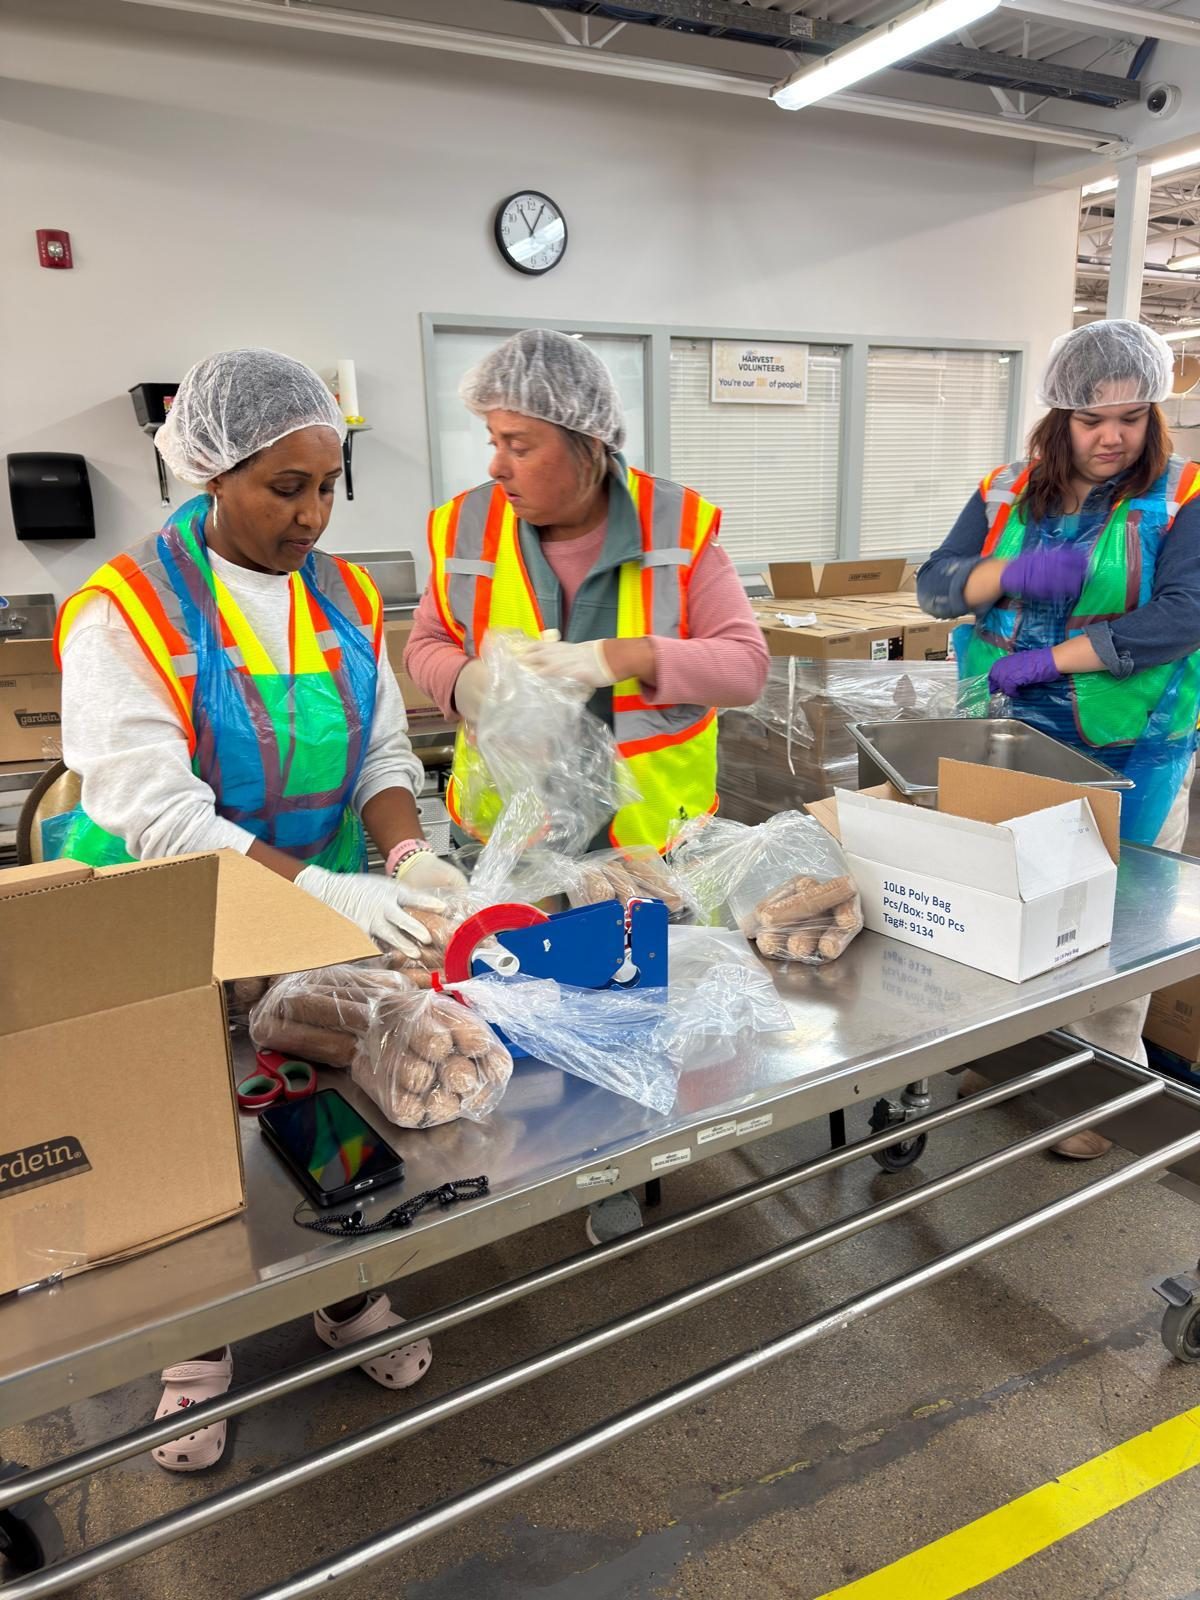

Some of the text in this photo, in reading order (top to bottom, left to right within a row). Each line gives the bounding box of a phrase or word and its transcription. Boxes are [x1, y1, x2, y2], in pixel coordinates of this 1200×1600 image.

[742, 355, 774, 364] HARVEST
[738, 363, 785, 373] VOLUNTEERS
[719, 378, 741, 387] You're
[769, 380, 777, 388] of
[777, 380, 802, 389] people!
[21, 712, 57, 725] gardein
[883, 880, 952, 913] 10LB Poly Bag
[883, 896, 965, 933] Pcs/Box: 500 Pcs
[882, 912, 934, 938] Tag#: 9134
